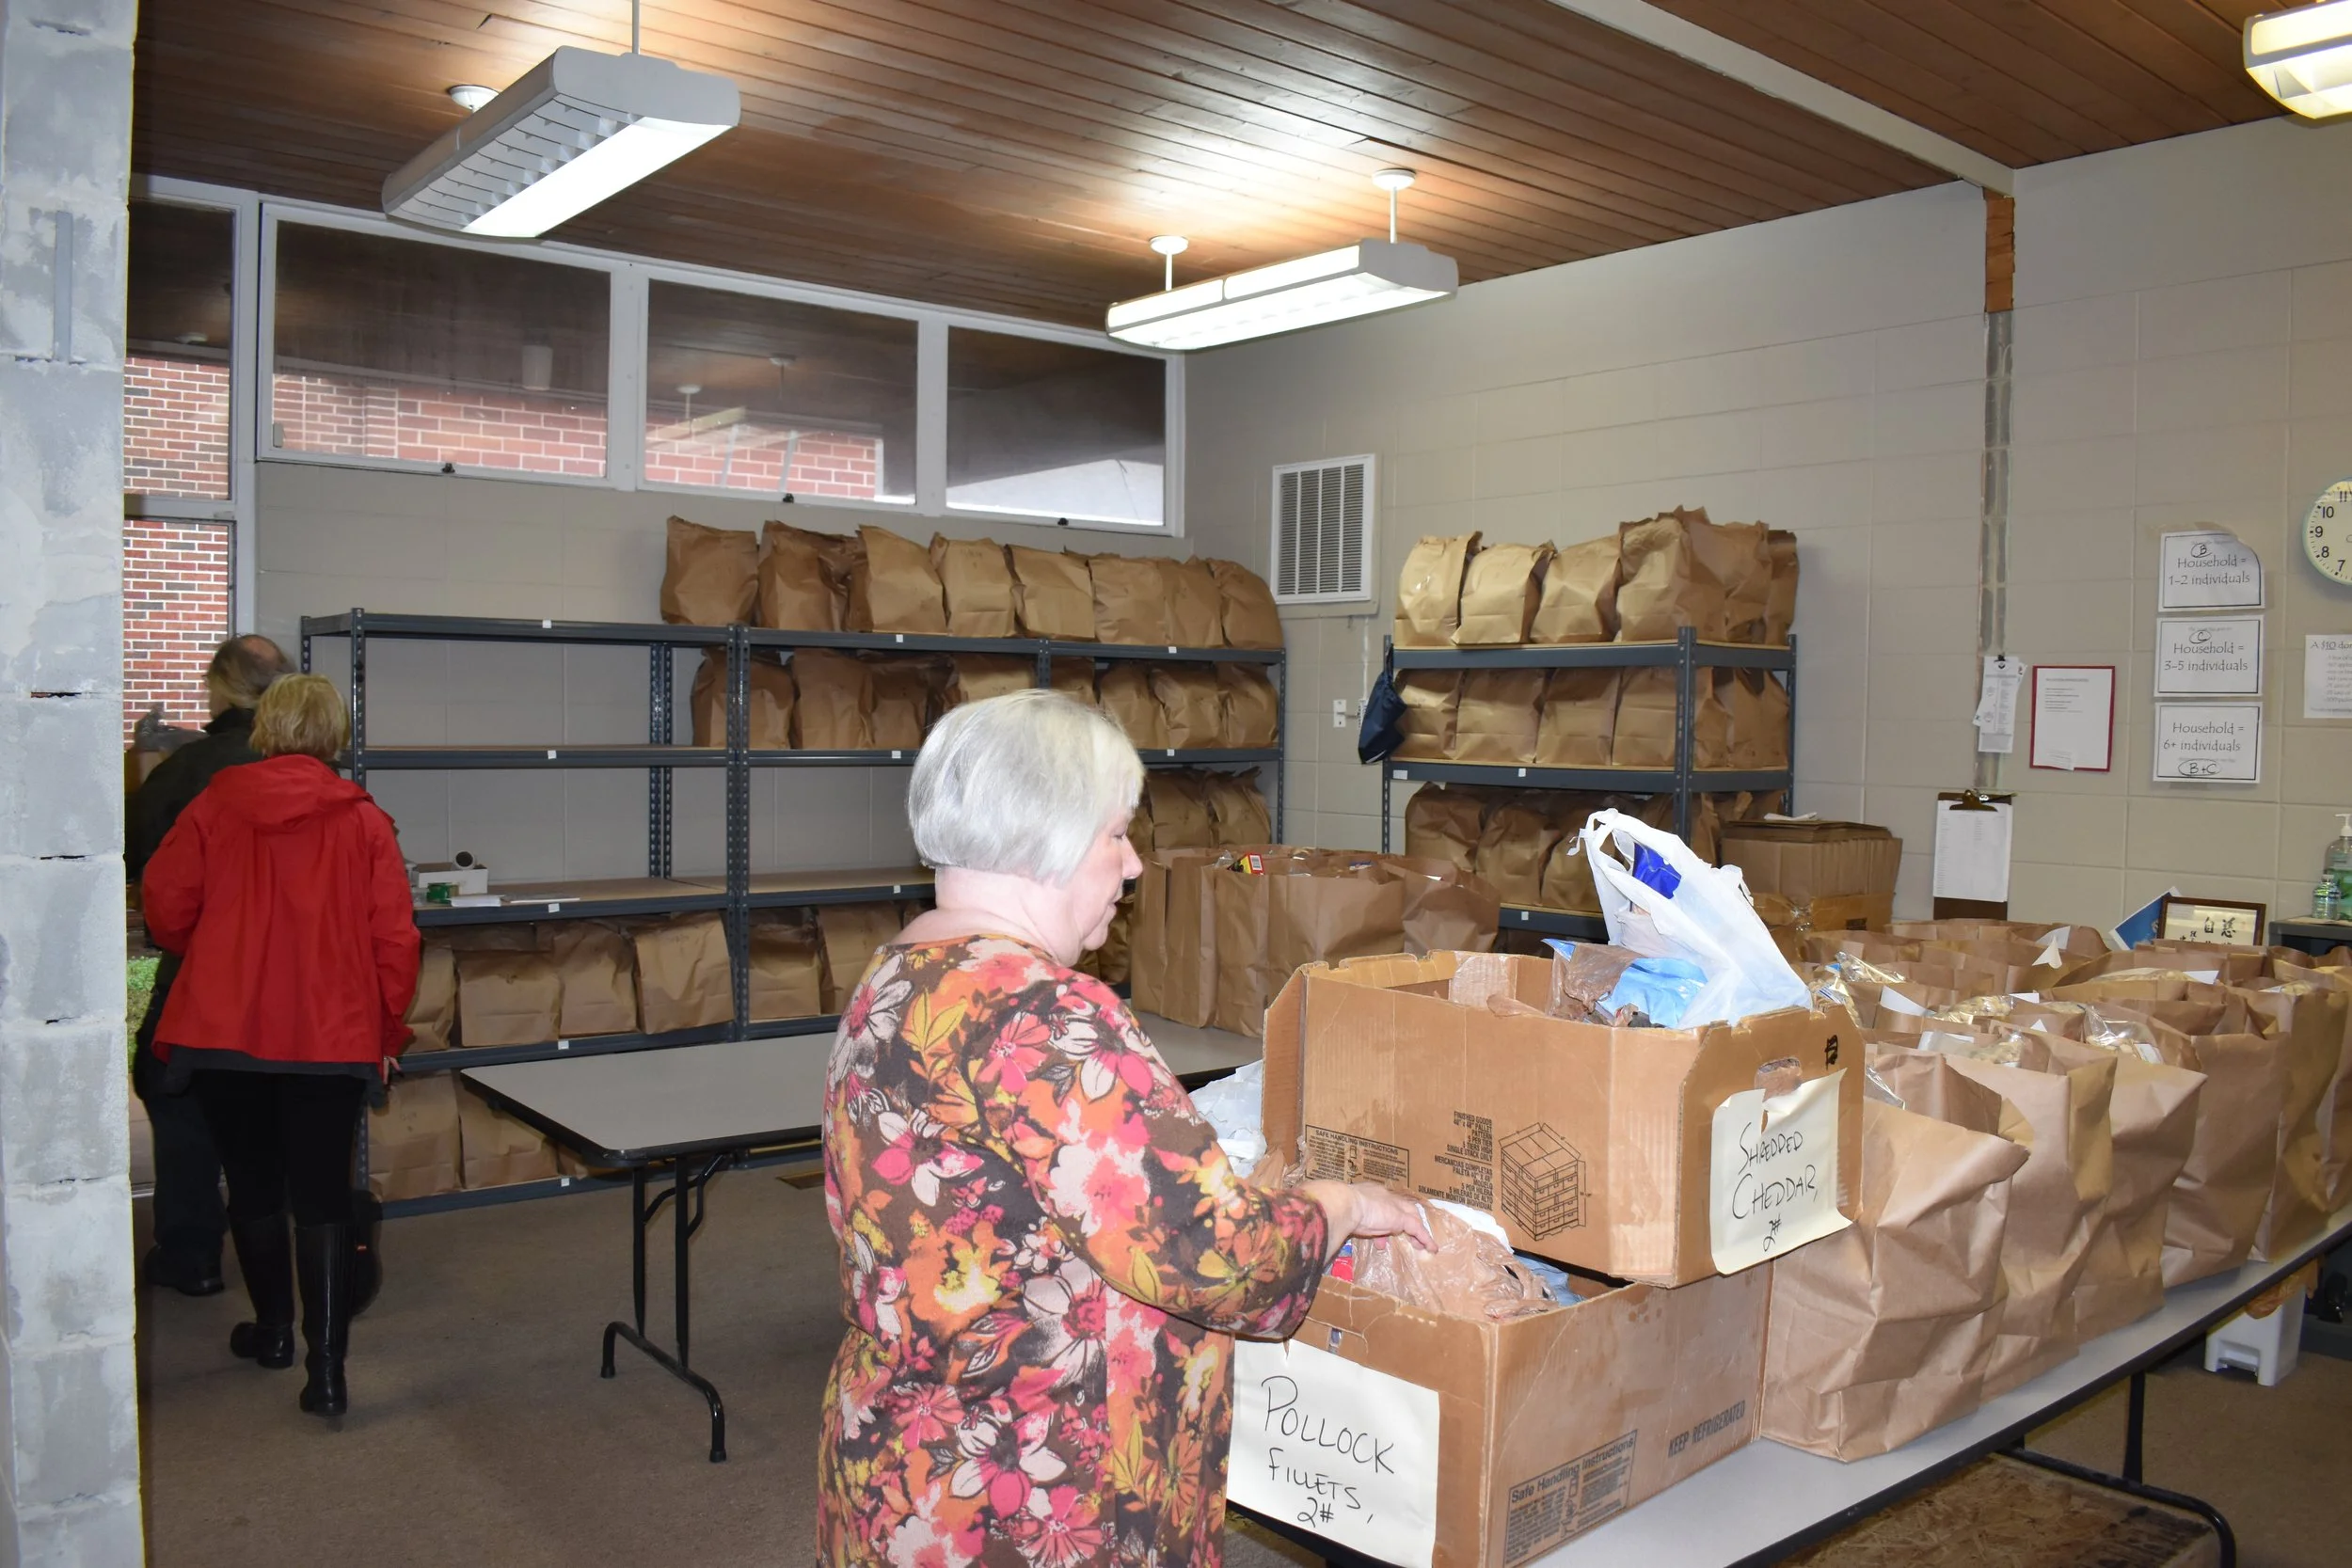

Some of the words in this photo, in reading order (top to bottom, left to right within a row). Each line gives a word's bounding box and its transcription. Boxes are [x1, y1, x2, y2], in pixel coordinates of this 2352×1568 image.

[2322, 506, 2334, 518] 10
[2314, 526, 2323, 537] 9
[2321, 546, 2329, 558] 8
[2177, 554, 2237, 568] Household
[2337, 560, 2345, 572] 7
[2169, 575, 2188, 585] 1-2
[2191, 571, 2250, 585] individuals
[2173, 641, 2234, 654] Household
[2164, 660, 2185, 671] 3-5
[2188, 658, 2249, 672] individuals
[2172, 721, 2234, 735] Household
[2163, 738, 2176, 750] 6+
[2181, 739, 2241, 752] individuals
[1454, 1111, 1475, 1122] FINISHED
[1475, 1117, 1492, 1126] GOODS
[1471, 1130, 1492, 1139] PATTERN
[1475, 1123, 1492, 1132] PALLET
[1315, 1130, 1329, 1138] SAFE
[1329, 1132, 1359, 1146] HANDLING
[1359, 1139, 1399, 1155] INSTRUCTIONS
[1467, 1142, 1480, 1151] TIERS
[1472, 1136, 1481, 1145] PER
[1482, 1139, 1492, 1148] TIER
[1739, 1122, 1804, 1176] SHREDDED
[1447, 1144, 1464, 1155] SINGLE
[1464, 1148, 1480, 1159] STACK
[1480, 1152, 1492, 1162] ONLY
[1435, 1155, 1464, 1167] MERCANCIAS
[1465, 1163, 1492, 1175] COMPLETAS
[1453, 1166, 1470, 1177] PALETA
[1472, 1179, 1492, 1190] MODELO
[1475, 1186, 1493, 1196] HILERA
[1418, 1185, 1444, 1199] SOLAMENTE
[1445, 1192, 1466, 1204] MONTON
[1466, 1196, 1493, 1211] INDIVIDUAL
[1453, 1187, 1473, 1197] HILERAS
[1481, 1194, 1493, 1204] ALTO
[1732, 1164, 1818, 1220] CHEDDAR,
[1262, 1375, 1394, 1475] POLLOCK
[1668, 1431, 1690, 1458] KEEP
[1692, 1400, 1746, 1446] REFRIGERATED
[1511, 1484, 1535, 1503] Safe
[1536, 1462, 1581, 1492] Handling
[1581, 1436, 1634, 1471] Instructions
[1297, 1497, 1335, 1528] 2#
